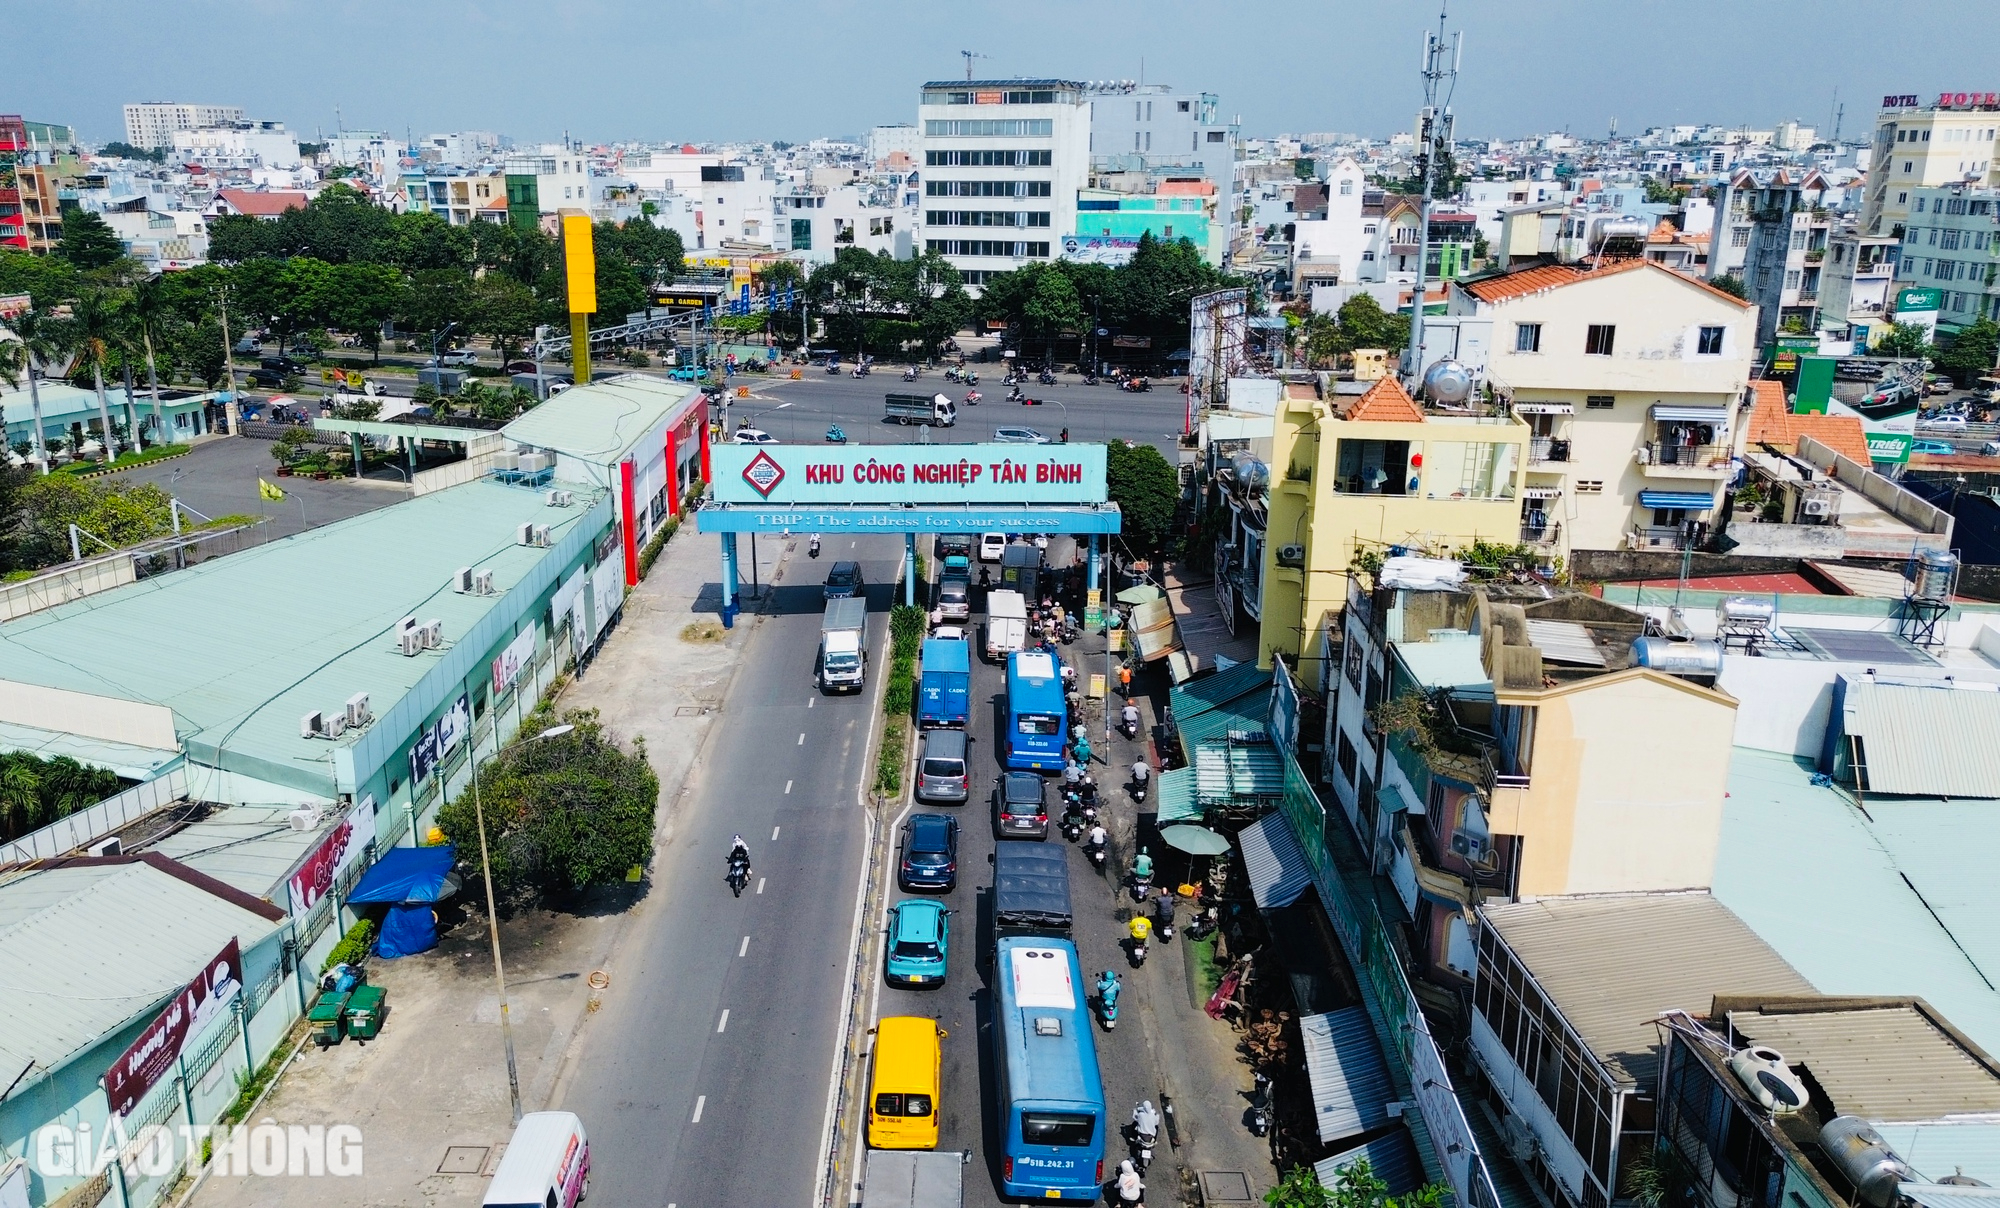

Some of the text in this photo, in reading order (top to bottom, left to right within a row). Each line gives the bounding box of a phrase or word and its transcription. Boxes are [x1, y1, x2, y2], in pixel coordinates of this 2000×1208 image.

[1883, 95, 1918, 107] HOTEL
[1939, 93, 2000, 106] HOTE
[678, 298, 702, 306] GARDEN
[806, 458, 1082, 488] KHU CÔNG NGHIỆP TÂN BÌNH
[815, 515, 851, 527] The
[857, 516, 919, 527] address
[925, 515, 951, 527] for
[956, 518, 995, 529] your
[1000, 517, 1060, 527] success
